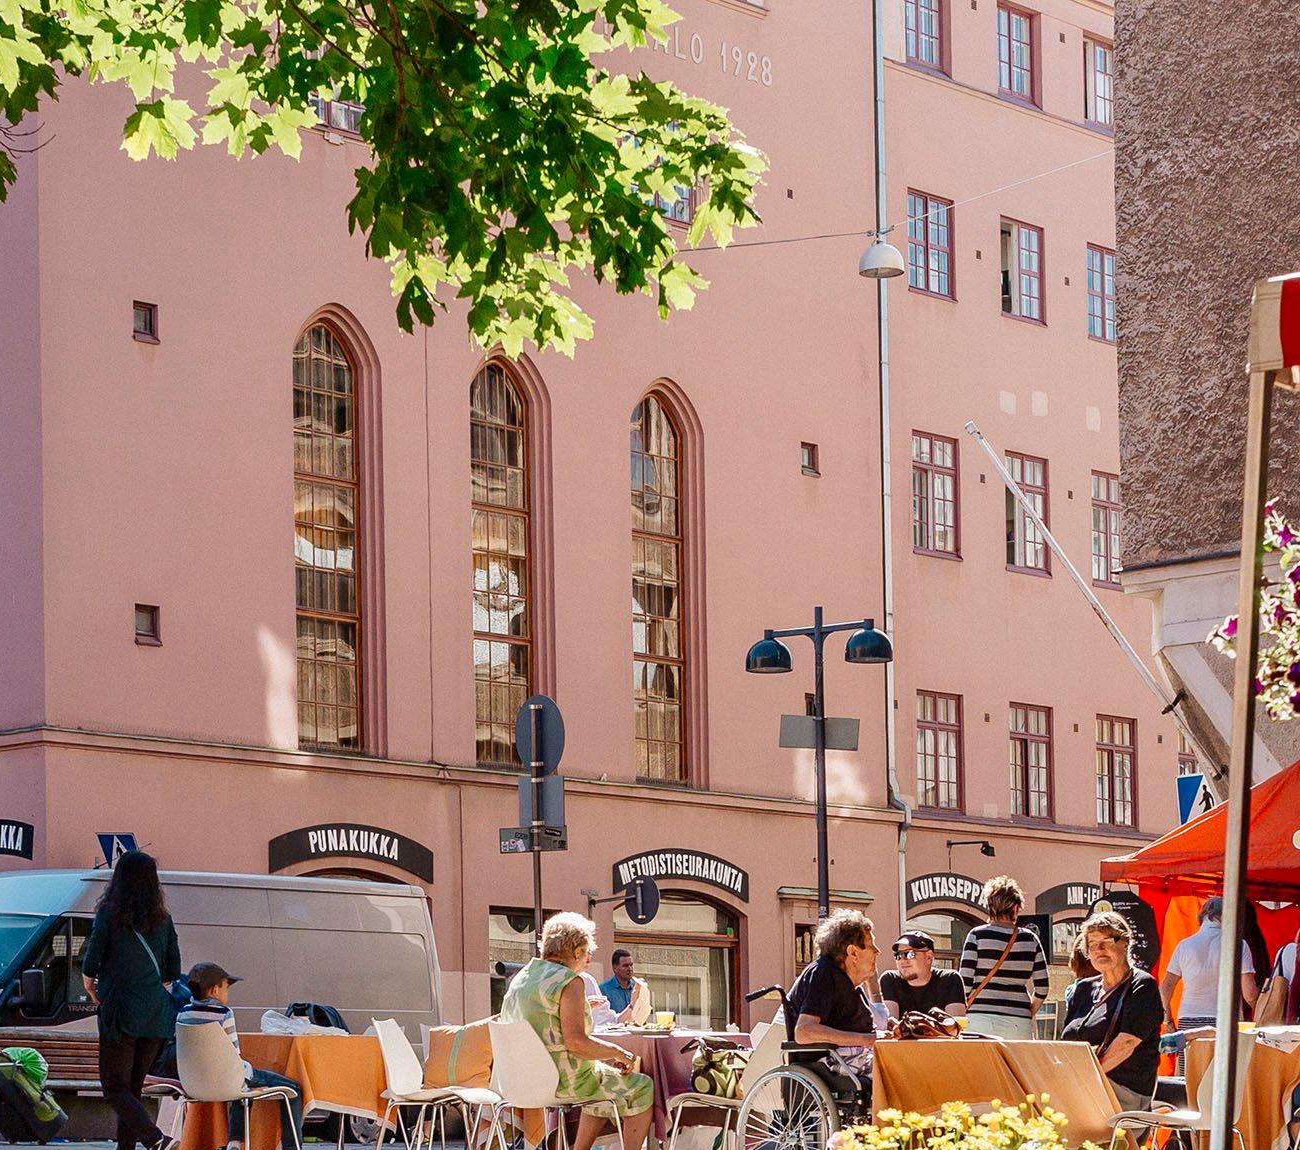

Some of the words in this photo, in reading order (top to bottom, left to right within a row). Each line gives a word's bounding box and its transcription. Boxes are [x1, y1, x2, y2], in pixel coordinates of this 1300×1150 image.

[721, 41, 772, 86] 1928
[308, 829, 399, 861] PUNAKUKKA
[618, 853, 744, 893] METODISTISEURAKUNTA
